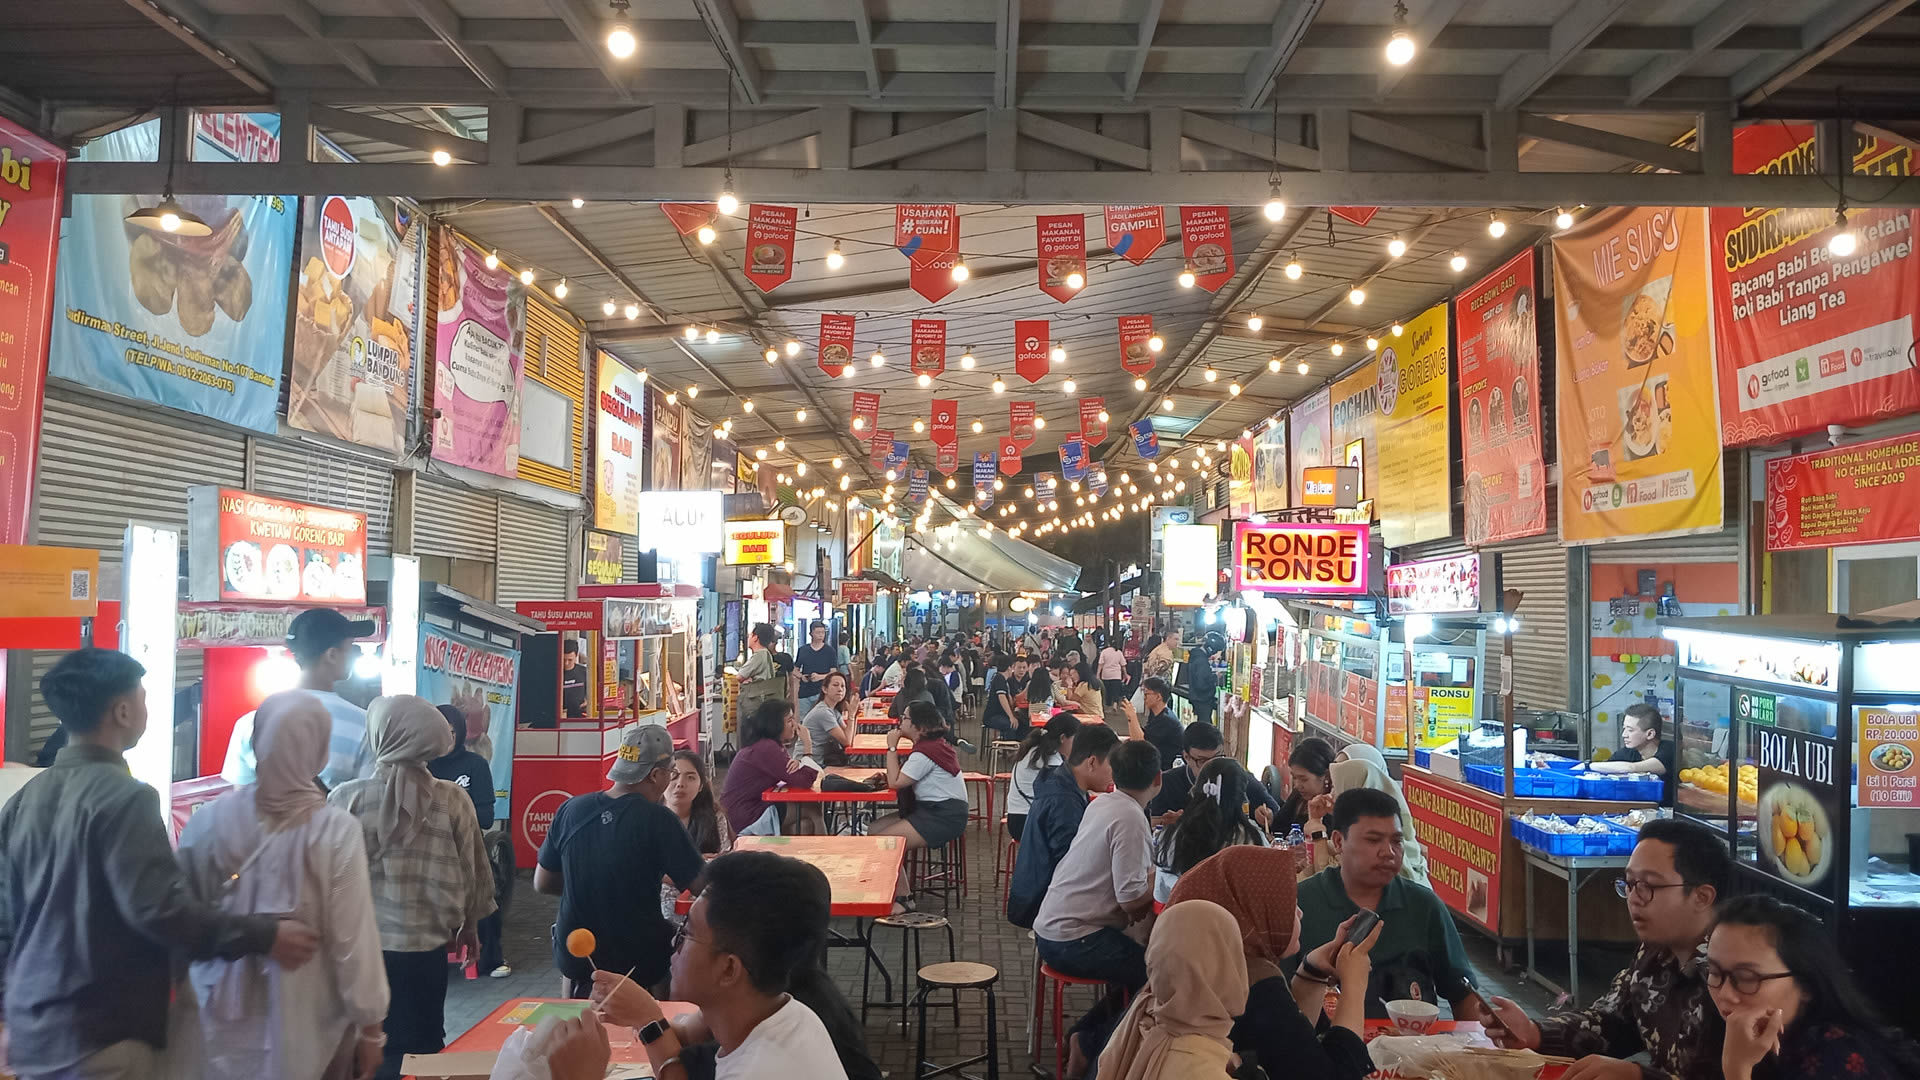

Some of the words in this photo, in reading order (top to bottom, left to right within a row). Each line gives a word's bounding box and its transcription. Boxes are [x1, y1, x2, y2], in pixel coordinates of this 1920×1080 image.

[753, 217, 792, 225] MAKANAN
[761, 210, 786, 218] PESAN
[902, 208, 949, 217] USAHANA
[1186, 217, 1225, 226] MAKANAN
[1192, 210, 1217, 218] PESAN
[1111, 218, 1159, 233] GAMPIL!
[1186, 225, 1217, 233] FAVORIT
[763, 232, 789, 240] gofood
[1199, 231, 1225, 241] gofood
[1053, 244, 1079, 252] gofood
[1591, 235, 1624, 289] MIE
[1626, 207, 1680, 272] SUSU
[1732, 269, 1775, 300] Bacang
[1777, 251, 1808, 280] Babi
[1855, 213, 1910, 244] Ketan
[1470, 295, 1484, 312] RICE
[1484, 286, 1501, 304] BOWL
[1733, 300, 1754, 322] Roti
[1756, 285, 1784, 312] Babi
[1787, 271, 1829, 299] Tanpa
[1779, 301, 1817, 327] Liang
[1819, 290, 1846, 311] Tea
[184, 347, 220, 371] Sudirman
[367, 340, 399, 366] LUMPIA
[1018, 351, 1047, 361] gofood
[367, 357, 406, 388] BANDUNG
[1399, 347, 1446, 395] GORENG
[1762, 366, 1790, 387] gofood
[656, 404, 679, 433] PANDU
[611, 432, 632, 459] BABI
[1811, 452, 1864, 470] TRADITIONAL
[1866, 441, 1919, 460] HOMEMADE
[1834, 467, 1849, 479] NO
[1849, 460, 1893, 476] CHEMICAL
[1854, 476, 1879, 489] SINCE
[1881, 471, 1906, 486] 2009
[1640, 489, 1656, 501] Food
[221, 497, 245, 515] NASI
[246, 500, 282, 521] GORENG
[285, 507, 305, 524] BABI
[250, 520, 292, 540] KWETIAW
[294, 525, 326, 545] GORENG
[327, 530, 345, 546] BABI
[742, 544, 767, 553] BABI
[1246, 533, 1357, 557] RONDE
[1246, 557, 1357, 582] RONSU
[531, 610, 546, 619] TAHU
[564, 611, 593, 620] ANTAPANI
[448, 641, 468, 673] TIE
[1431, 689, 1470, 698] RONSU
[1759, 697, 1774, 708] PORK
[1759, 708, 1774, 722] LARD
[1867, 714, 1896, 725] BOLA
[1898, 715, 1917, 725] UBI
[1865, 729, 1881, 740] RP.
[1884, 730, 1918, 741] 20.000
[1760, 731, 1800, 777] BOLA
[1804, 741, 1834, 785] UBI
[1866, 776, 1879, 787] Isi
[1891, 776, 1917, 787] Porsi
[1890, 790, 1913, 801] Biji)
[529, 812, 554, 821] TAHU
[1407, 785, 1431, 811] BACANG
[1431, 793, 1447, 818] BABI
[1447, 799, 1470, 828] BERAS
[1470, 808, 1495, 838] KETAN
[530, 823, 550, 832] ANT
[1419, 820, 1435, 844] BABI
[1435, 826, 1457, 856] TANPA
[1457, 837, 1497, 875] PENGAWET
[1430, 858, 1450, 885] LIANG
[1450, 867, 1464, 894] TEA
[1397, 1017, 1434, 1036] RON
